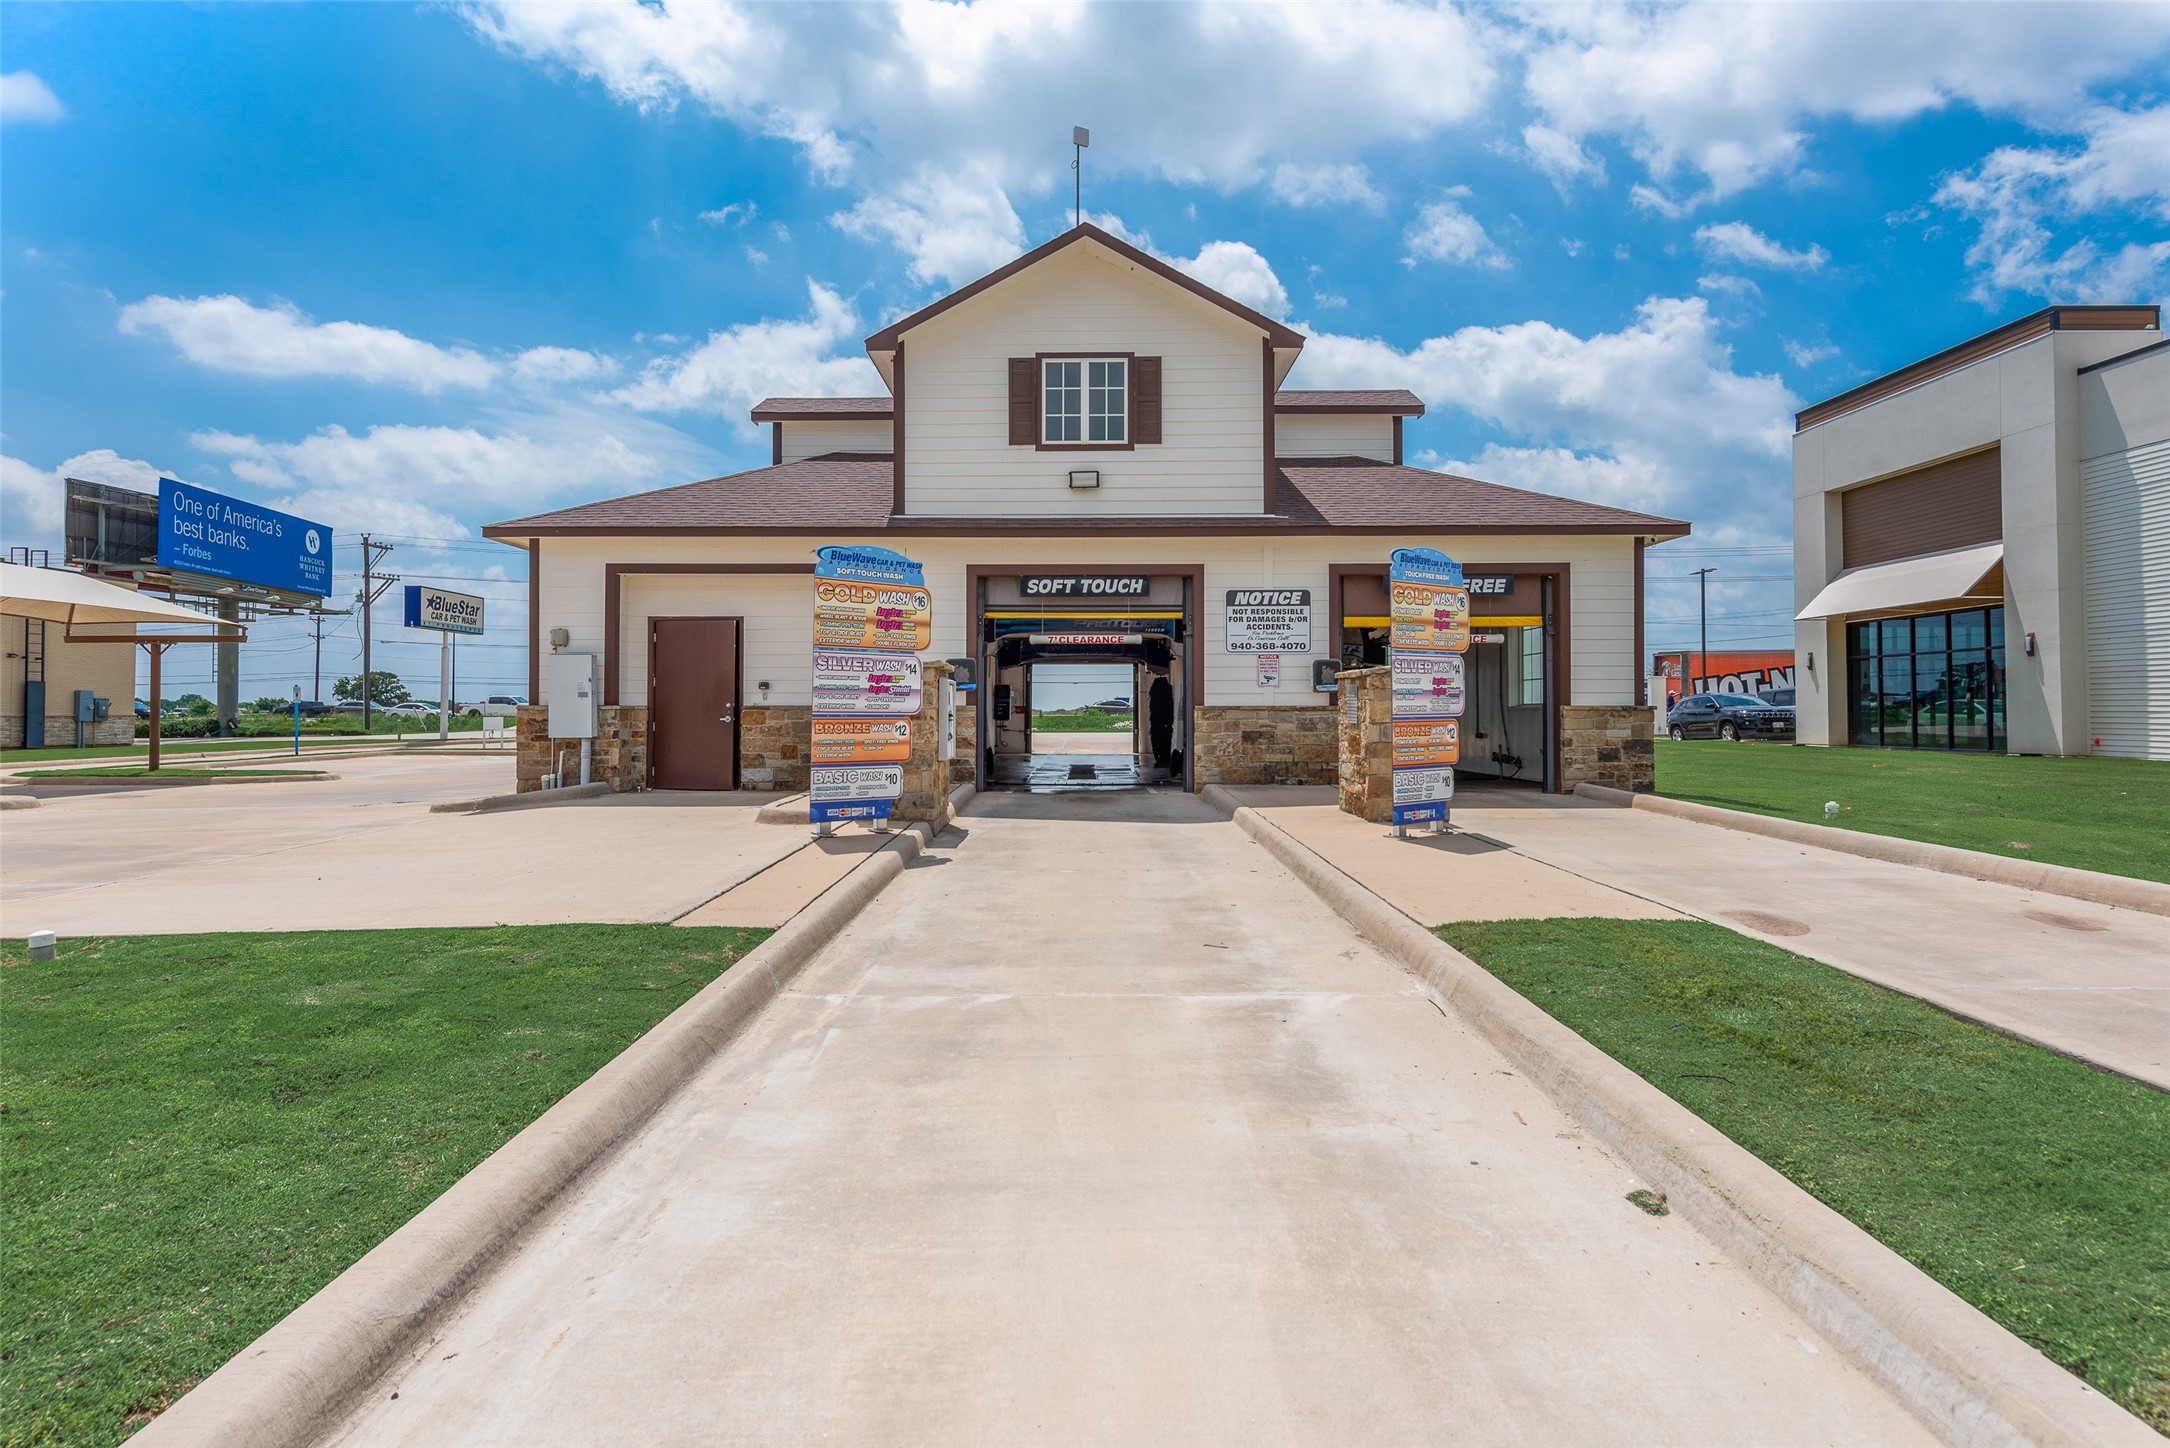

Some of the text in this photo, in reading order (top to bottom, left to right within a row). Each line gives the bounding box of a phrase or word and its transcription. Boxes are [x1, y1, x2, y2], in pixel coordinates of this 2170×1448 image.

[173, 491, 282, 537] One of America's
[174, 515, 250, 550] best banks.
[182, 543, 212, 561] Forbes
[830, 550, 877, 565] BlueWave
[876, 558, 888, 566] CAR
[895, 560, 906, 568] PET
[299, 555, 325, 567] HANCOCK
[846, 561, 922, 574] PROVIDENCE
[1400, 552, 1431, 566] BlueWave
[1451, 562, 1462, 570] WASH
[299, 563, 325, 575] WHITNEY
[305, 571, 320, 581] BANK
[836, 568, 904, 580] SOFT TOUCH WASH
[1422, 572, 1435, 580] FREE
[1435, 573, 1450, 581] WASH
[1027, 579, 1144, 594] SOFT TOUCH
[817, 582, 926, 607] GOLD WASH $16
[1234, 592, 1302, 605] NOTICE
[1393, 585, 1432, 606] GOLD
[1433, 592, 1455, 606] WASH
[433, 596, 480, 617] BlueStar
[431, 612, 477, 625] CAR & PET WASH
[1230, 642, 1306, 650] 940-368-4070
[816, 656, 917, 675] SILVER WASH $14
[1394, 658, 1432, 674] SILVER
[1433, 661, 1450, 673] WASH
[814, 723, 907, 736] BRONZE WASH $12
[1394, 725, 1455, 739] BRONZE WASH $12
[813, 771, 897, 785] BASIC WASH $10
[1394, 773, 1451, 787] BASIC WASH $10
